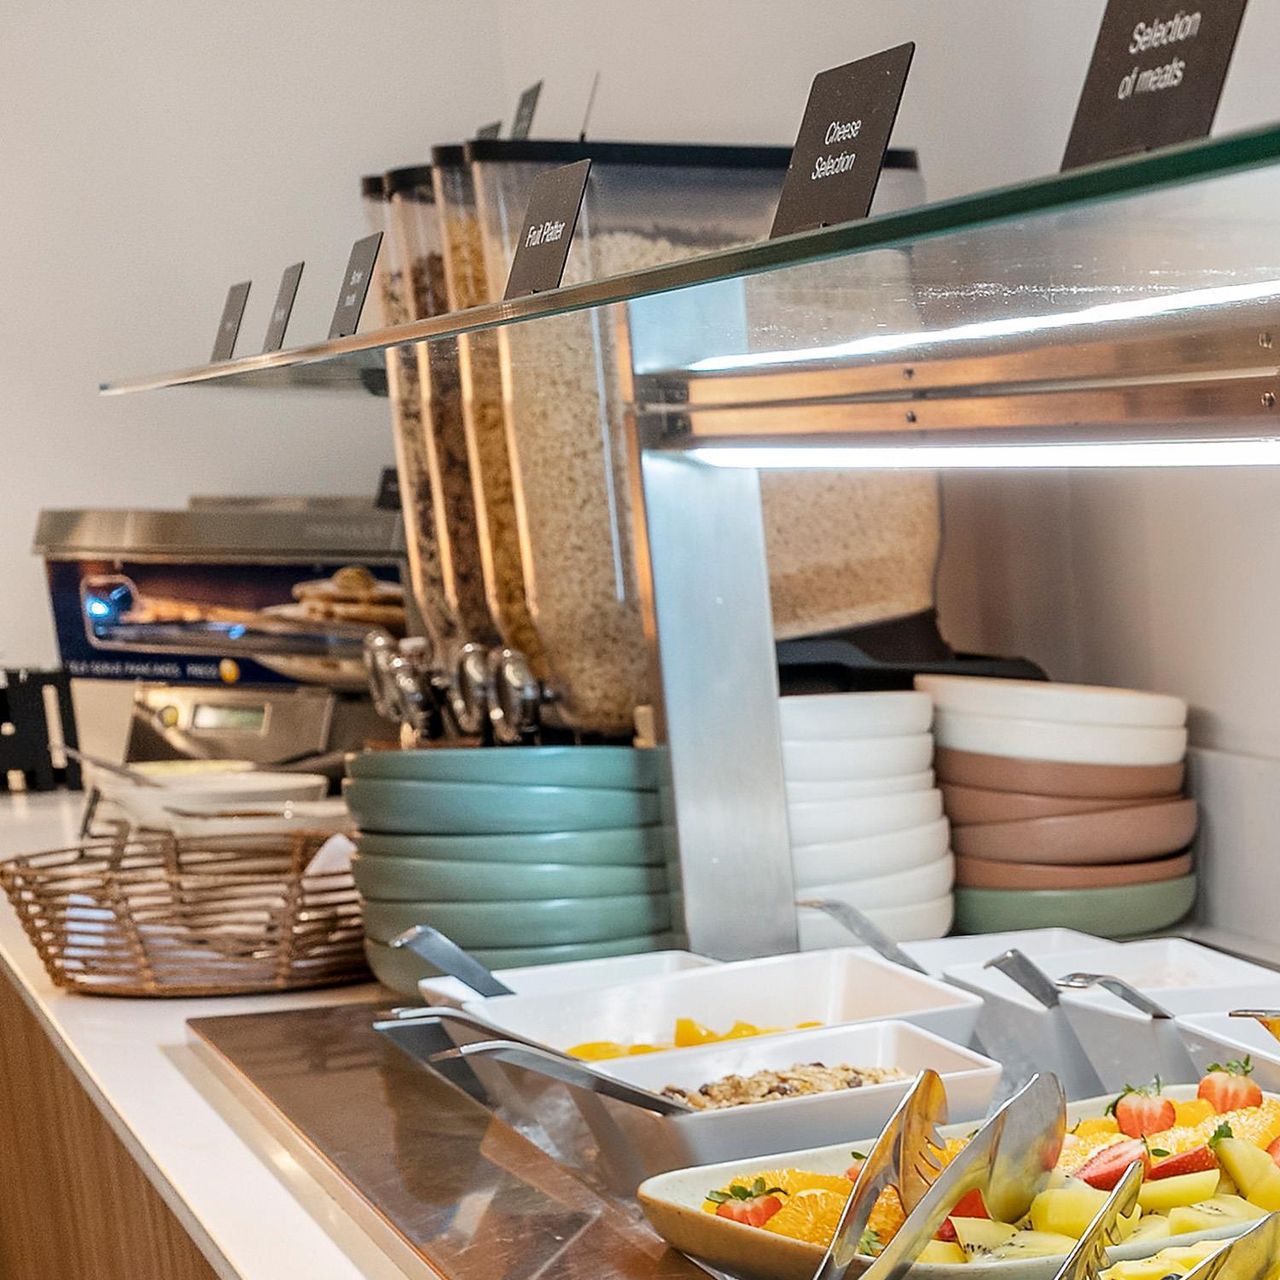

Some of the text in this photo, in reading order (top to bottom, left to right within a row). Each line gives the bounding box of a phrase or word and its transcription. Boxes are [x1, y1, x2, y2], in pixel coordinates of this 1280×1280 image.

[1128, 10, 1201, 54] Selection
[1118, 57, 1185, 99] of meats
[824, 120, 861, 145] Cheese
[811, 150, 856, 180] Selection
[525, 220, 566, 248] Fruit Platter
